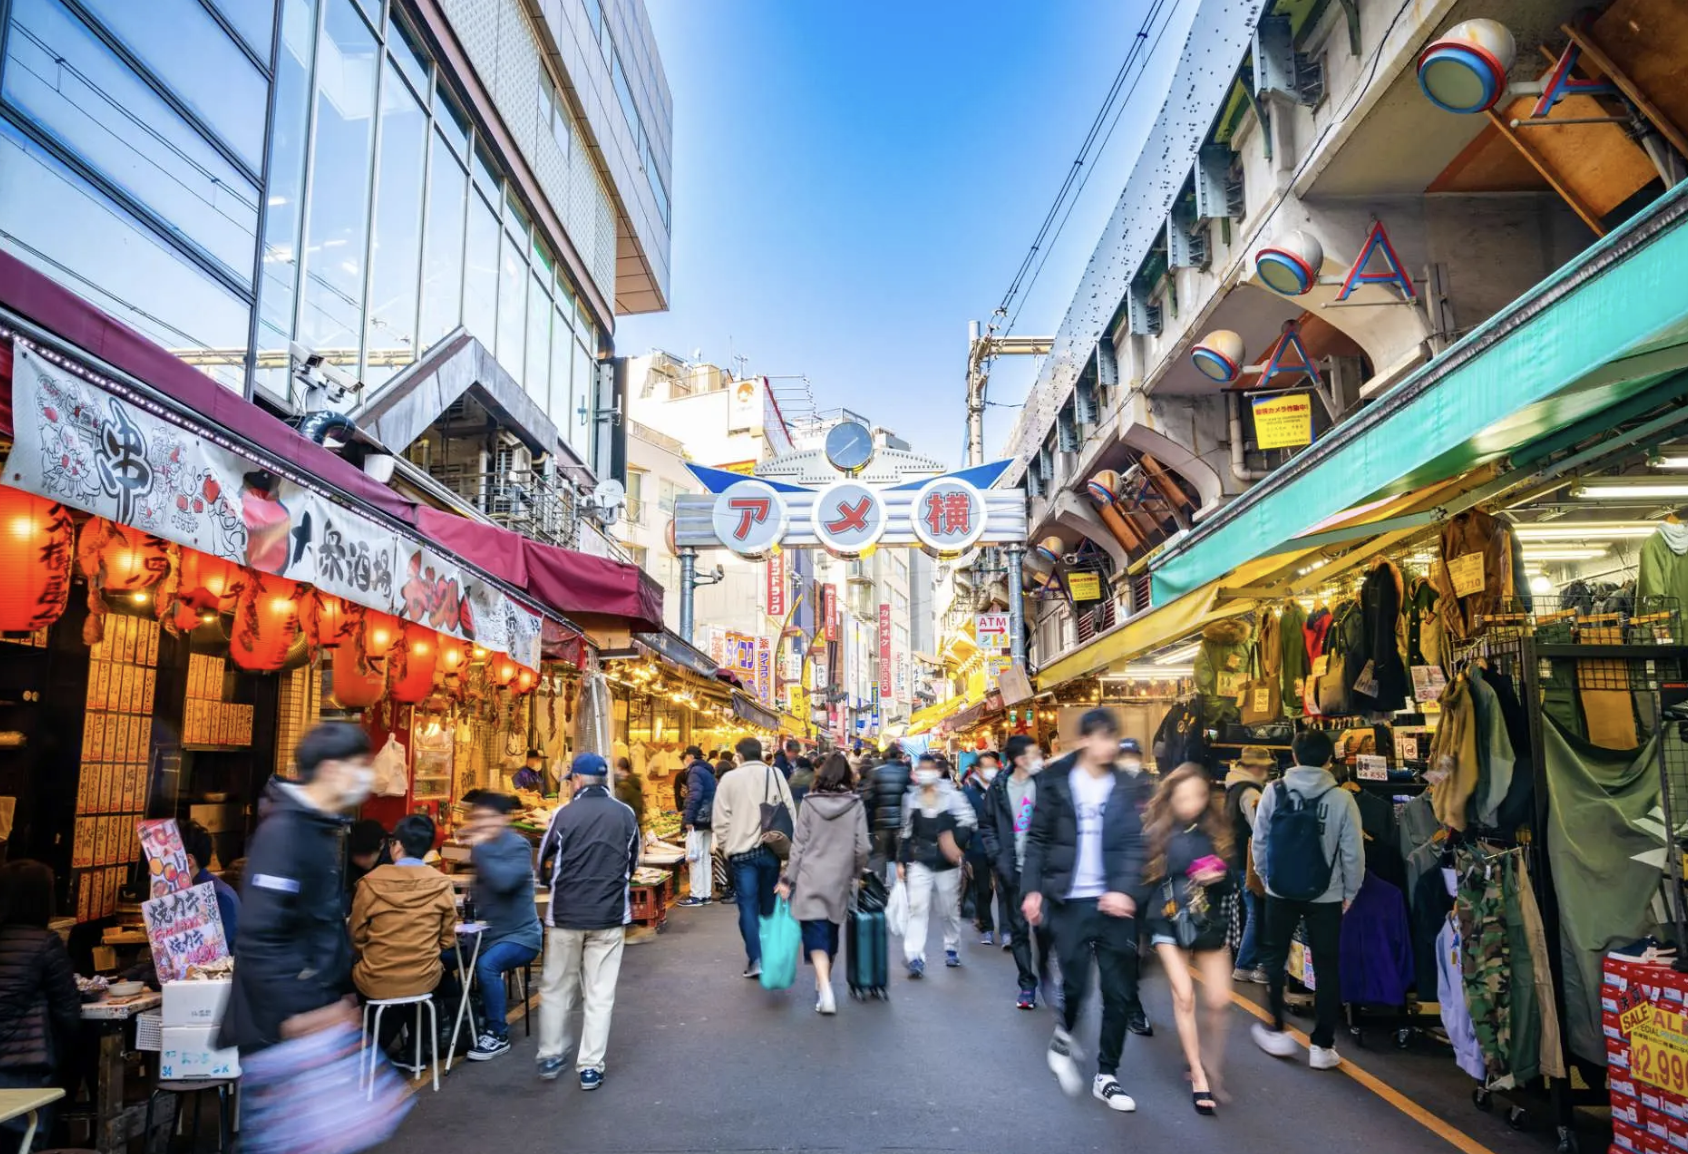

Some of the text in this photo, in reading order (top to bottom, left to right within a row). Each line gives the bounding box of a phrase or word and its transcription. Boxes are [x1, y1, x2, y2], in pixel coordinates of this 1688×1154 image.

[728, 492, 971, 541] アメ横
[881, 609, 890, 647] カラオケ
[979, 617, 1007, 627] ATM
[1623, 1004, 1650, 1030] SALE
